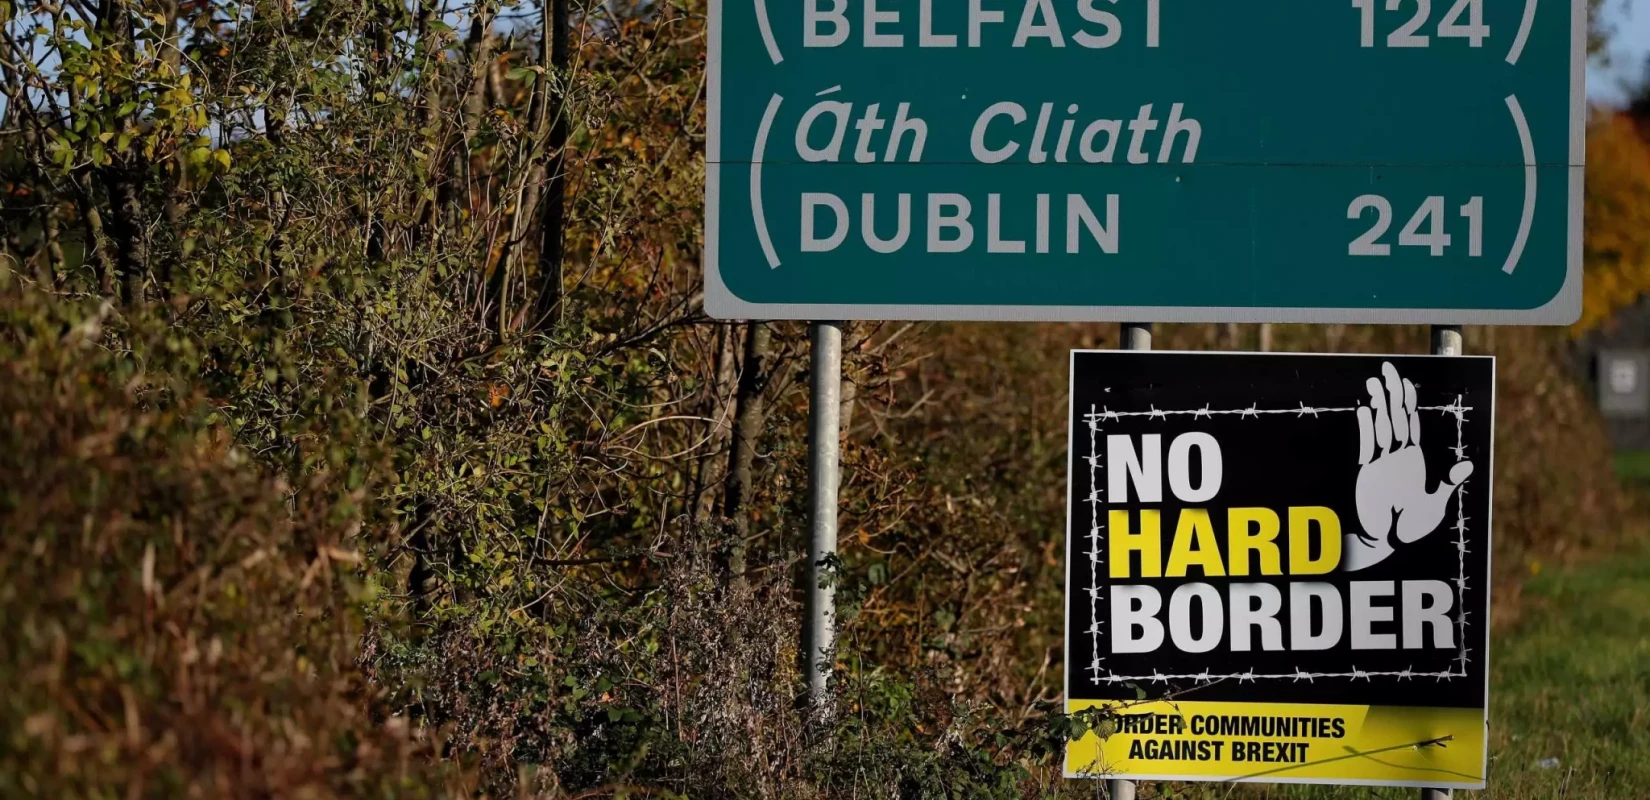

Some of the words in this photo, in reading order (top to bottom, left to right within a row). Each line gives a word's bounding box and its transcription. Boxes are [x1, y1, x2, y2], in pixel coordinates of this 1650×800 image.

[1351, 0, 1490, 48] 124
[794, 84, 928, 163] Áth
[970, 100, 1202, 165] Cliath
[800, 192, 1120, 254] DUBLIN
[1346, 194, 1483, 257] 241
[1107, 431, 1223, 503] NO
[1108, 505, 1342, 578] HARD
[1110, 579, 1457, 654] BORDER
[1100, 713, 1183, 735] ORDER
[1190, 714, 1346, 739] COMMUNITIES
[1128, 738, 1225, 762] AGAINST
[1231, 742, 1310, 764] BREXIT
